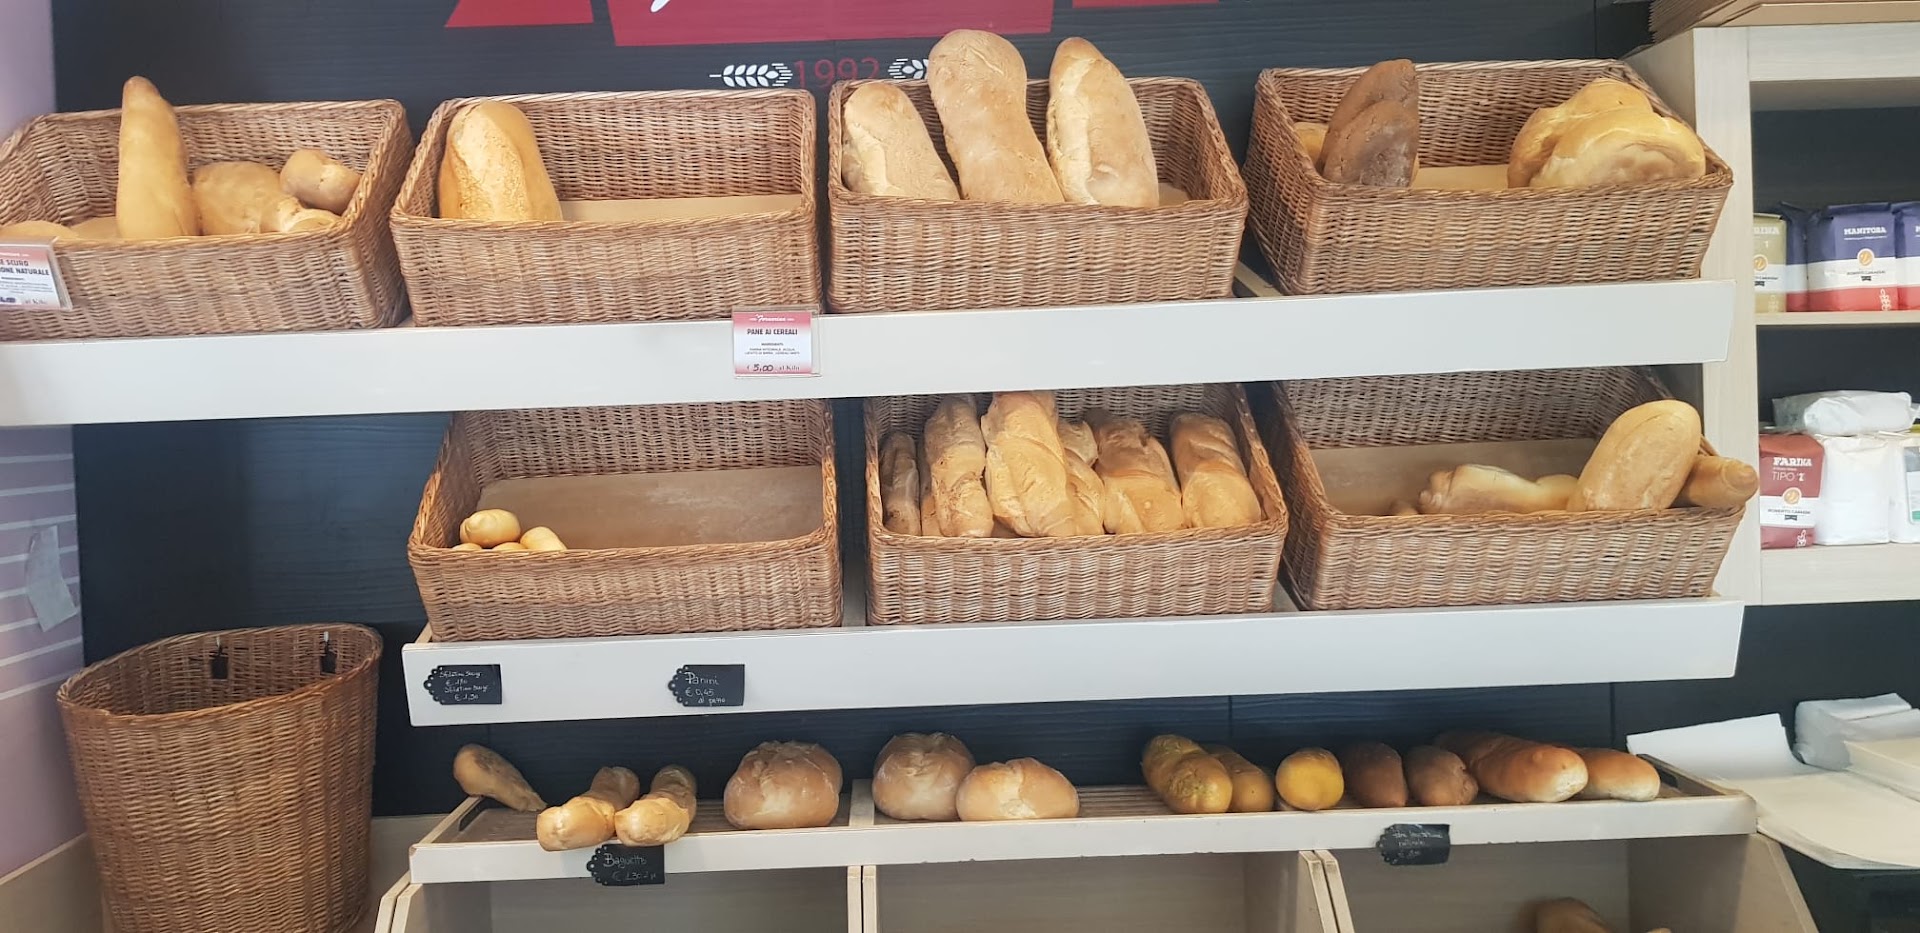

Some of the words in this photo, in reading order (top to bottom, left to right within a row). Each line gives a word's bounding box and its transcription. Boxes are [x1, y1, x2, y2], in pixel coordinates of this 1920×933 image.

[794, 57, 880, 89] 1992
[1843, 226, 1887, 236] MANITOBA
[6, 259, 29, 267] SCURO
[15, 267, 50, 276] NATURALE
[1773, 456, 1812, 467] FARINA
[1772, 471, 1795, 481] TIPO
[684, 671, 719, 685] Panini
[454, 693, 461, 701] €
[685, 687, 693, 697] €
